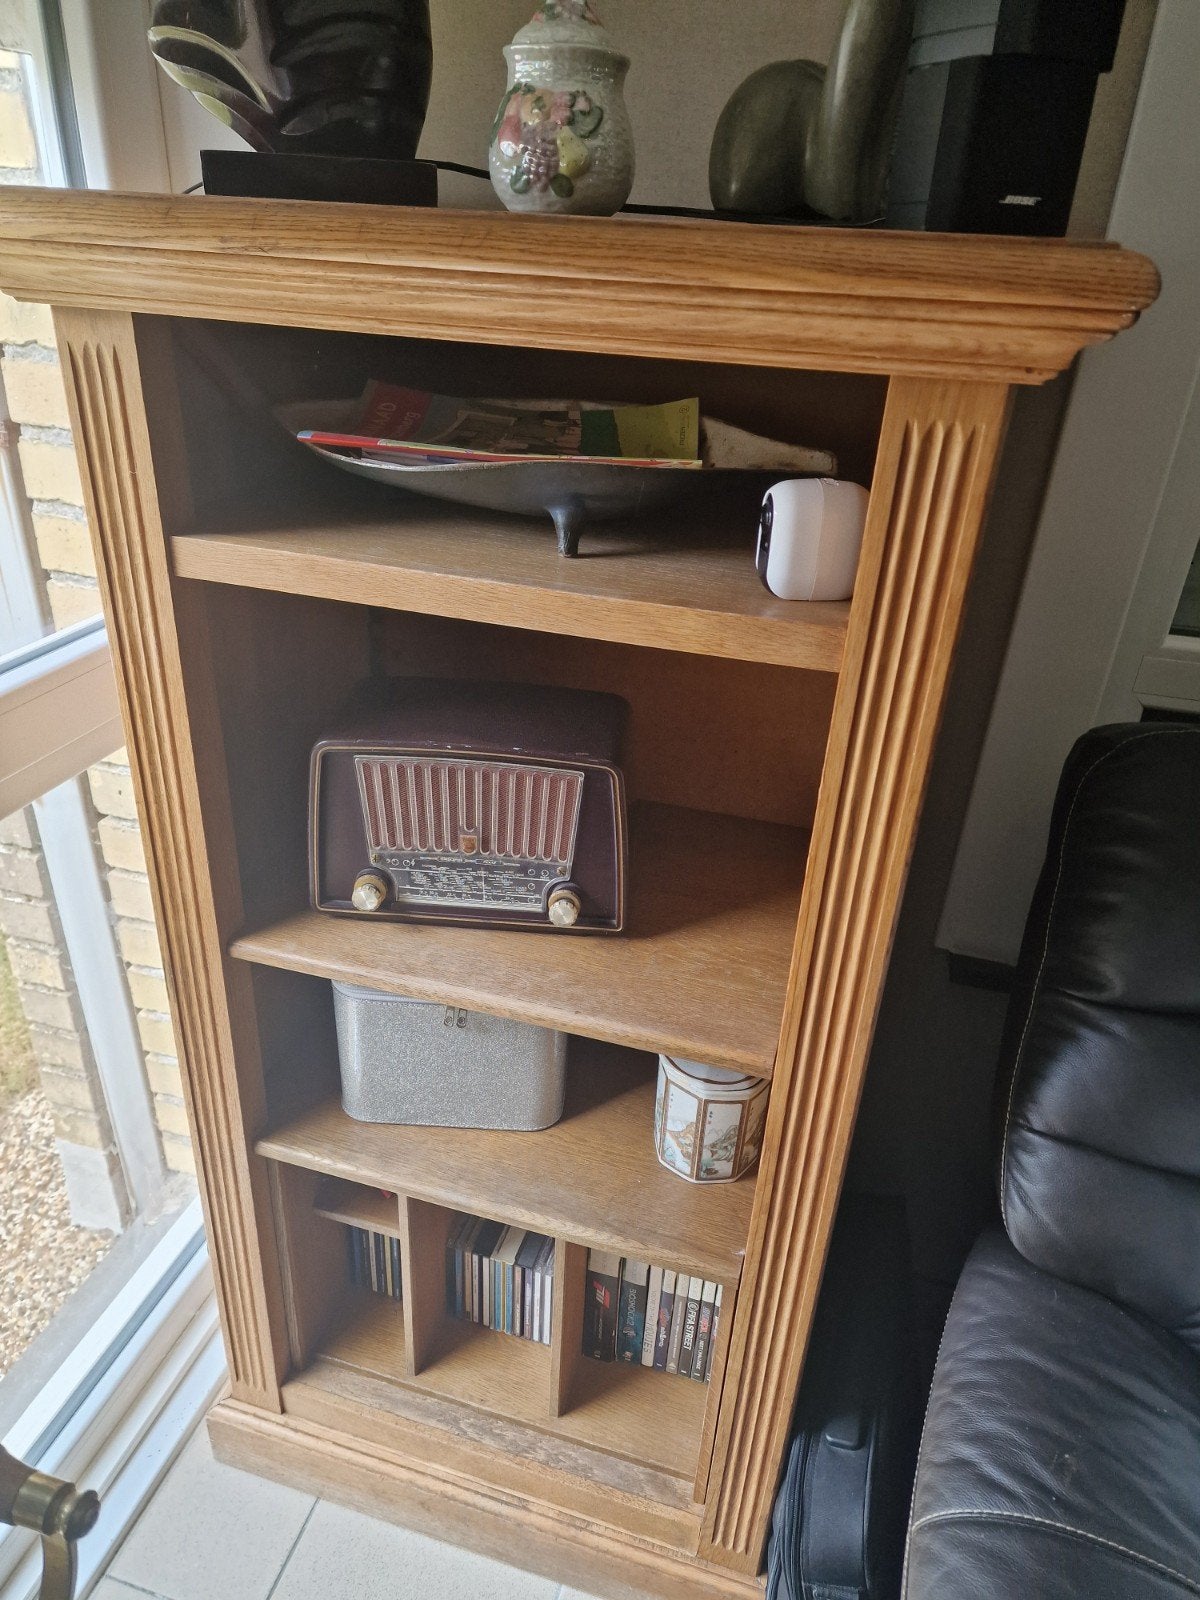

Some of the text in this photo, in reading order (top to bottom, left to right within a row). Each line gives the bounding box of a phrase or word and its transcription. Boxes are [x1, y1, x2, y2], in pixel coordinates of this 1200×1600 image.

[626, 1288, 637, 1320] BIOSHOCK
[643, 1321, 655, 1354] MOVIES
[683, 1310, 697, 1351] FIFA STREET
